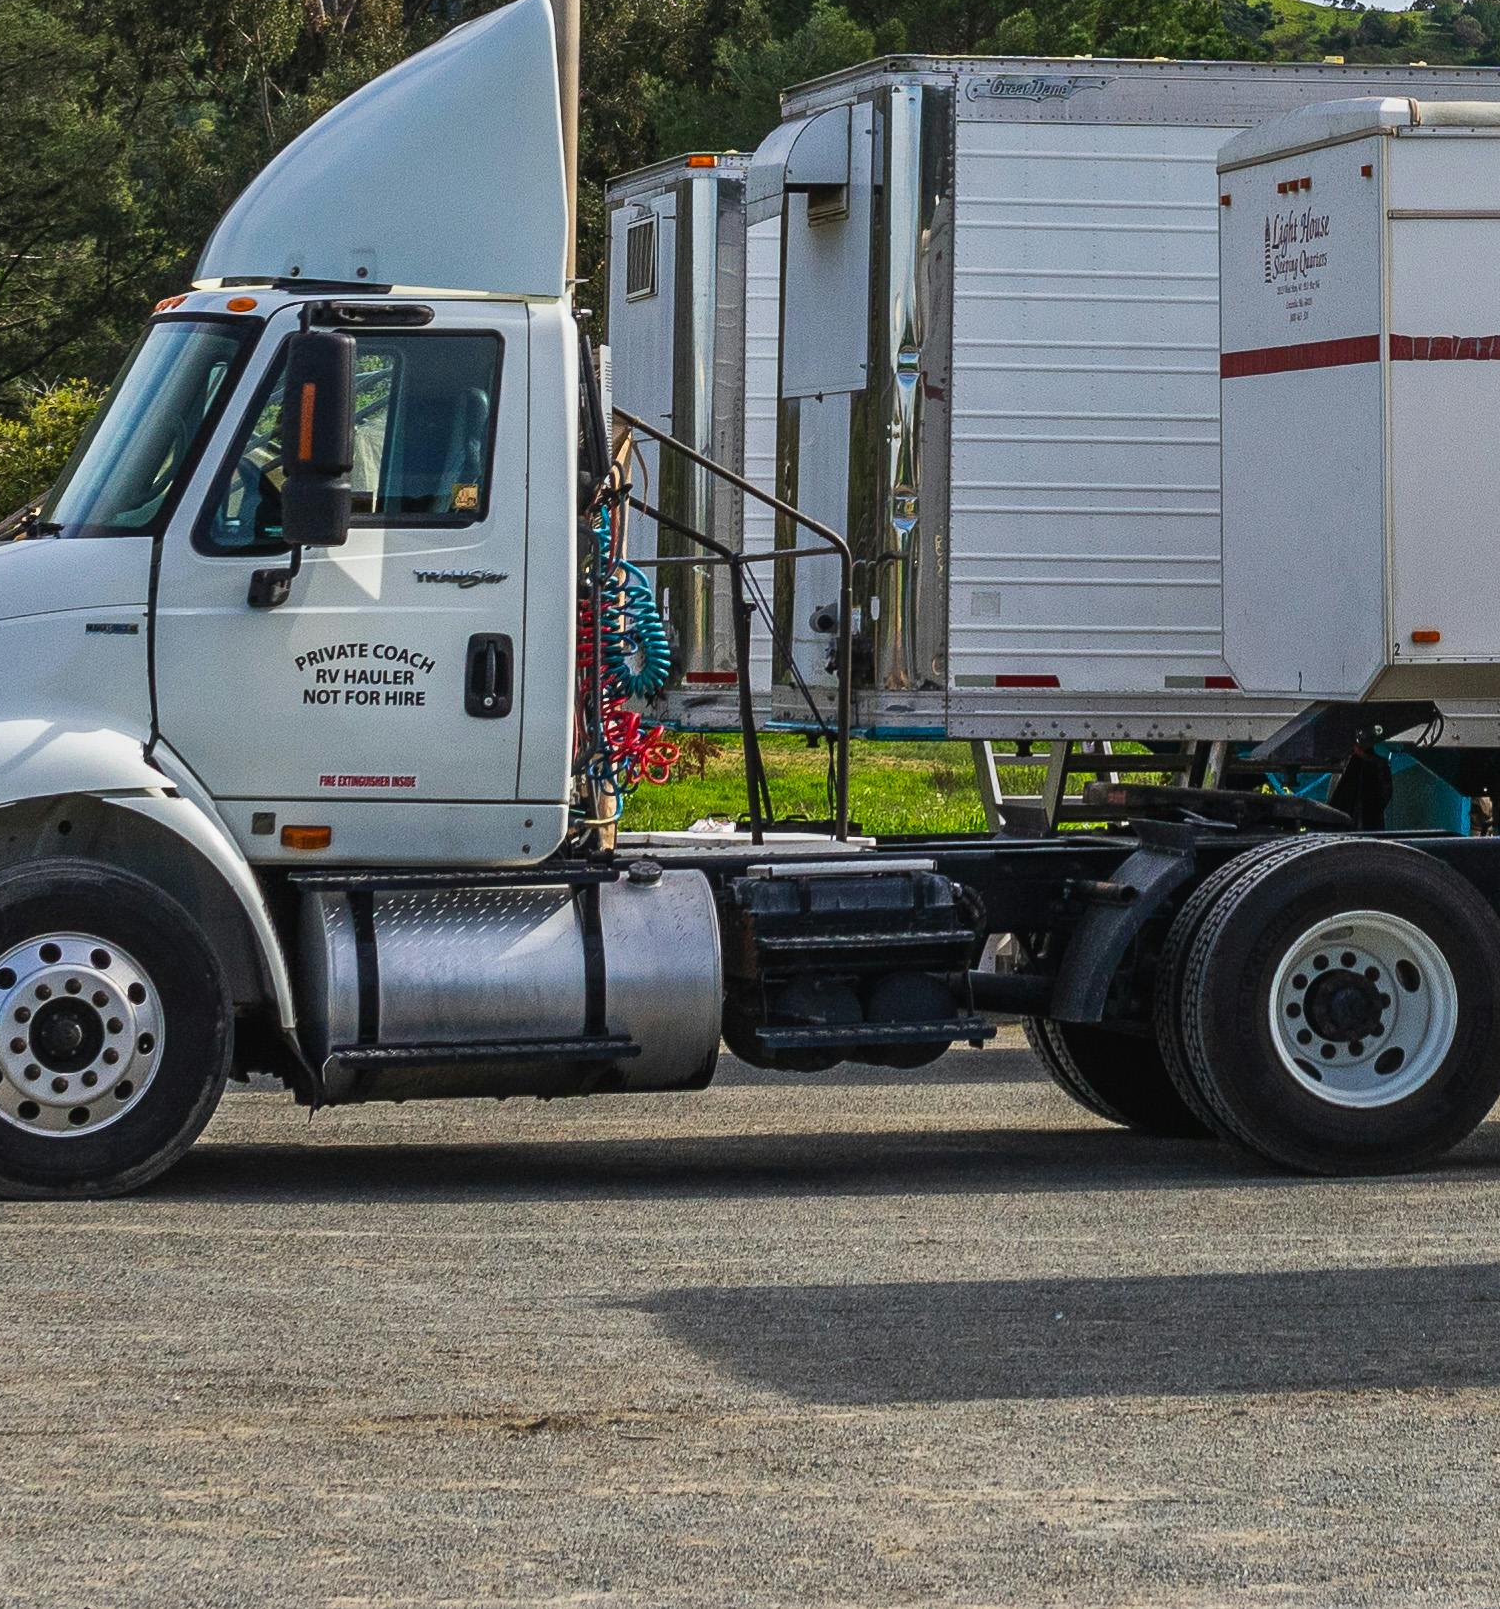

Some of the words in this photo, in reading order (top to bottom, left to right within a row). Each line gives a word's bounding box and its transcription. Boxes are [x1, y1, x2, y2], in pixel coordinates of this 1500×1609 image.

[990, 77, 1031, 96] Great
[1031, 78, 1069, 96] Dane
[1271, 209, 1298, 259] Light
[1299, 206, 1330, 243] House
[1272, 255, 1299, 281] Sleeping
[1299, 249, 1328, 278] Quarters
[294, 643, 369, 672] PRIVATE
[372, 643, 436, 674] COACH
[1394, 642, 1401, 657] 2
[315, 668, 341, 684] RV
[343, 669, 415, 686] HAULER
[302, 689, 342, 705] NOT
[344, 690, 381, 706] FOR
[384, 691, 426, 707] HIRE
[319, 775, 337, 788] FIRE
[337, 775, 391, 788] EXTINGUISHER
[391, 775, 417, 788] INSIDE
